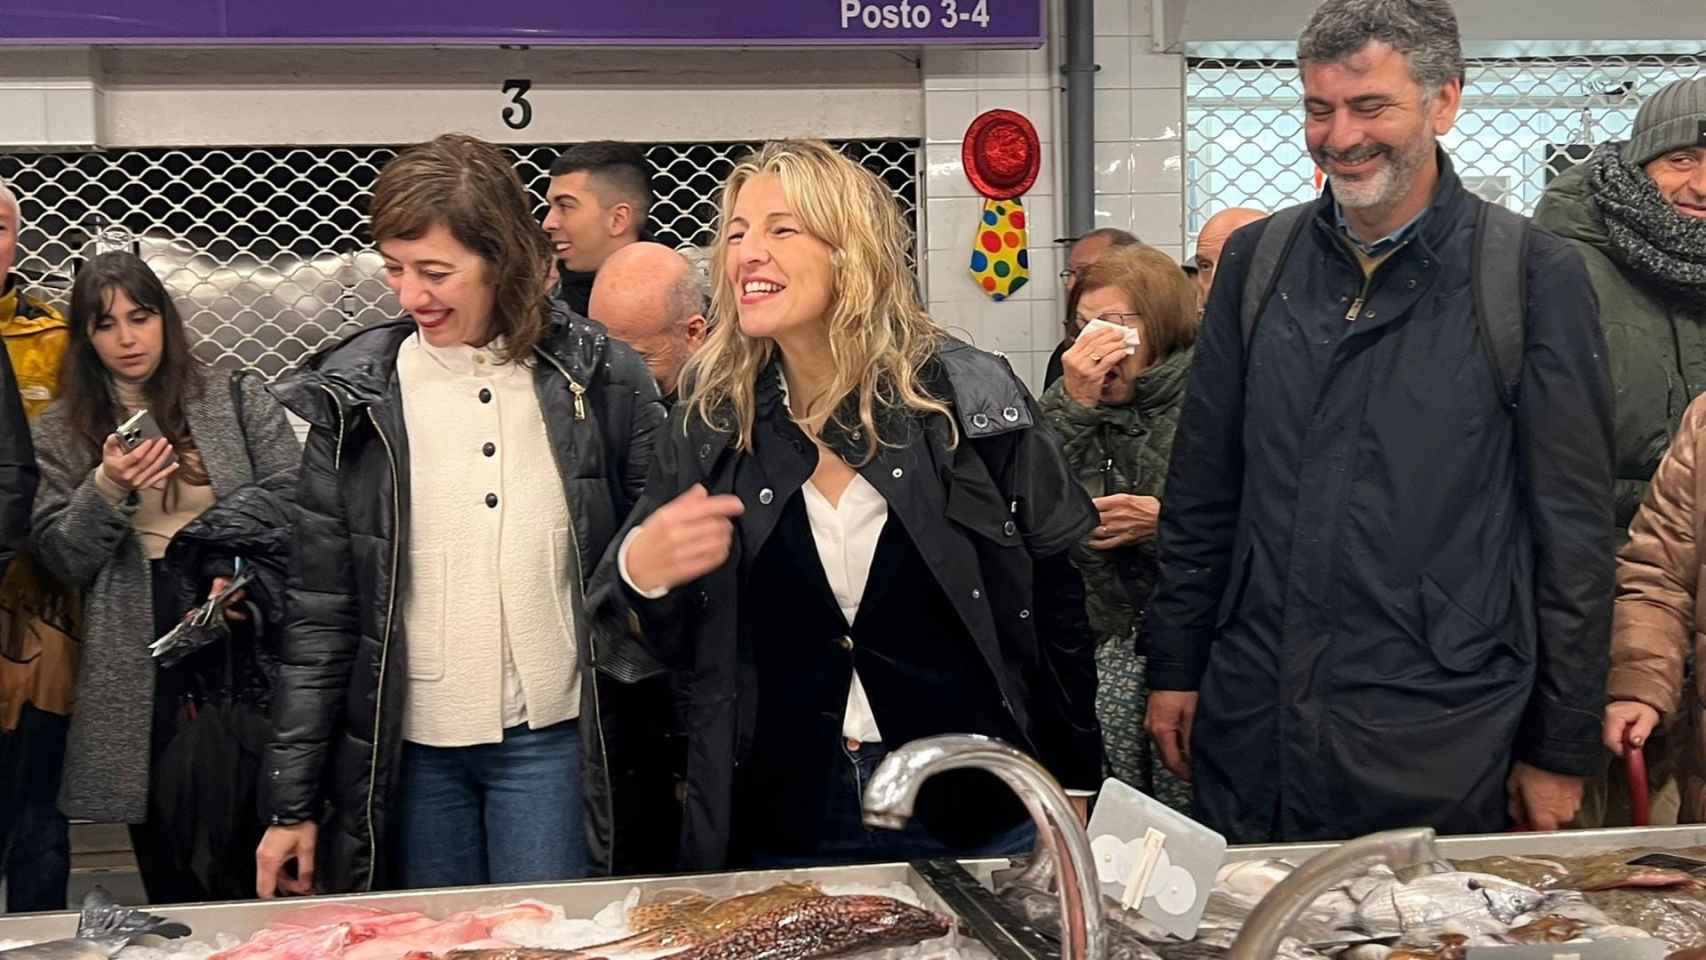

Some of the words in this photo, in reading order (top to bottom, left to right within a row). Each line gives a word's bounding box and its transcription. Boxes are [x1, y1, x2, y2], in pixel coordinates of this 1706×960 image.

[840, 0, 931, 29] Posto
[940, 0, 990, 29] 3-4
[501, 79, 532, 130] 3
